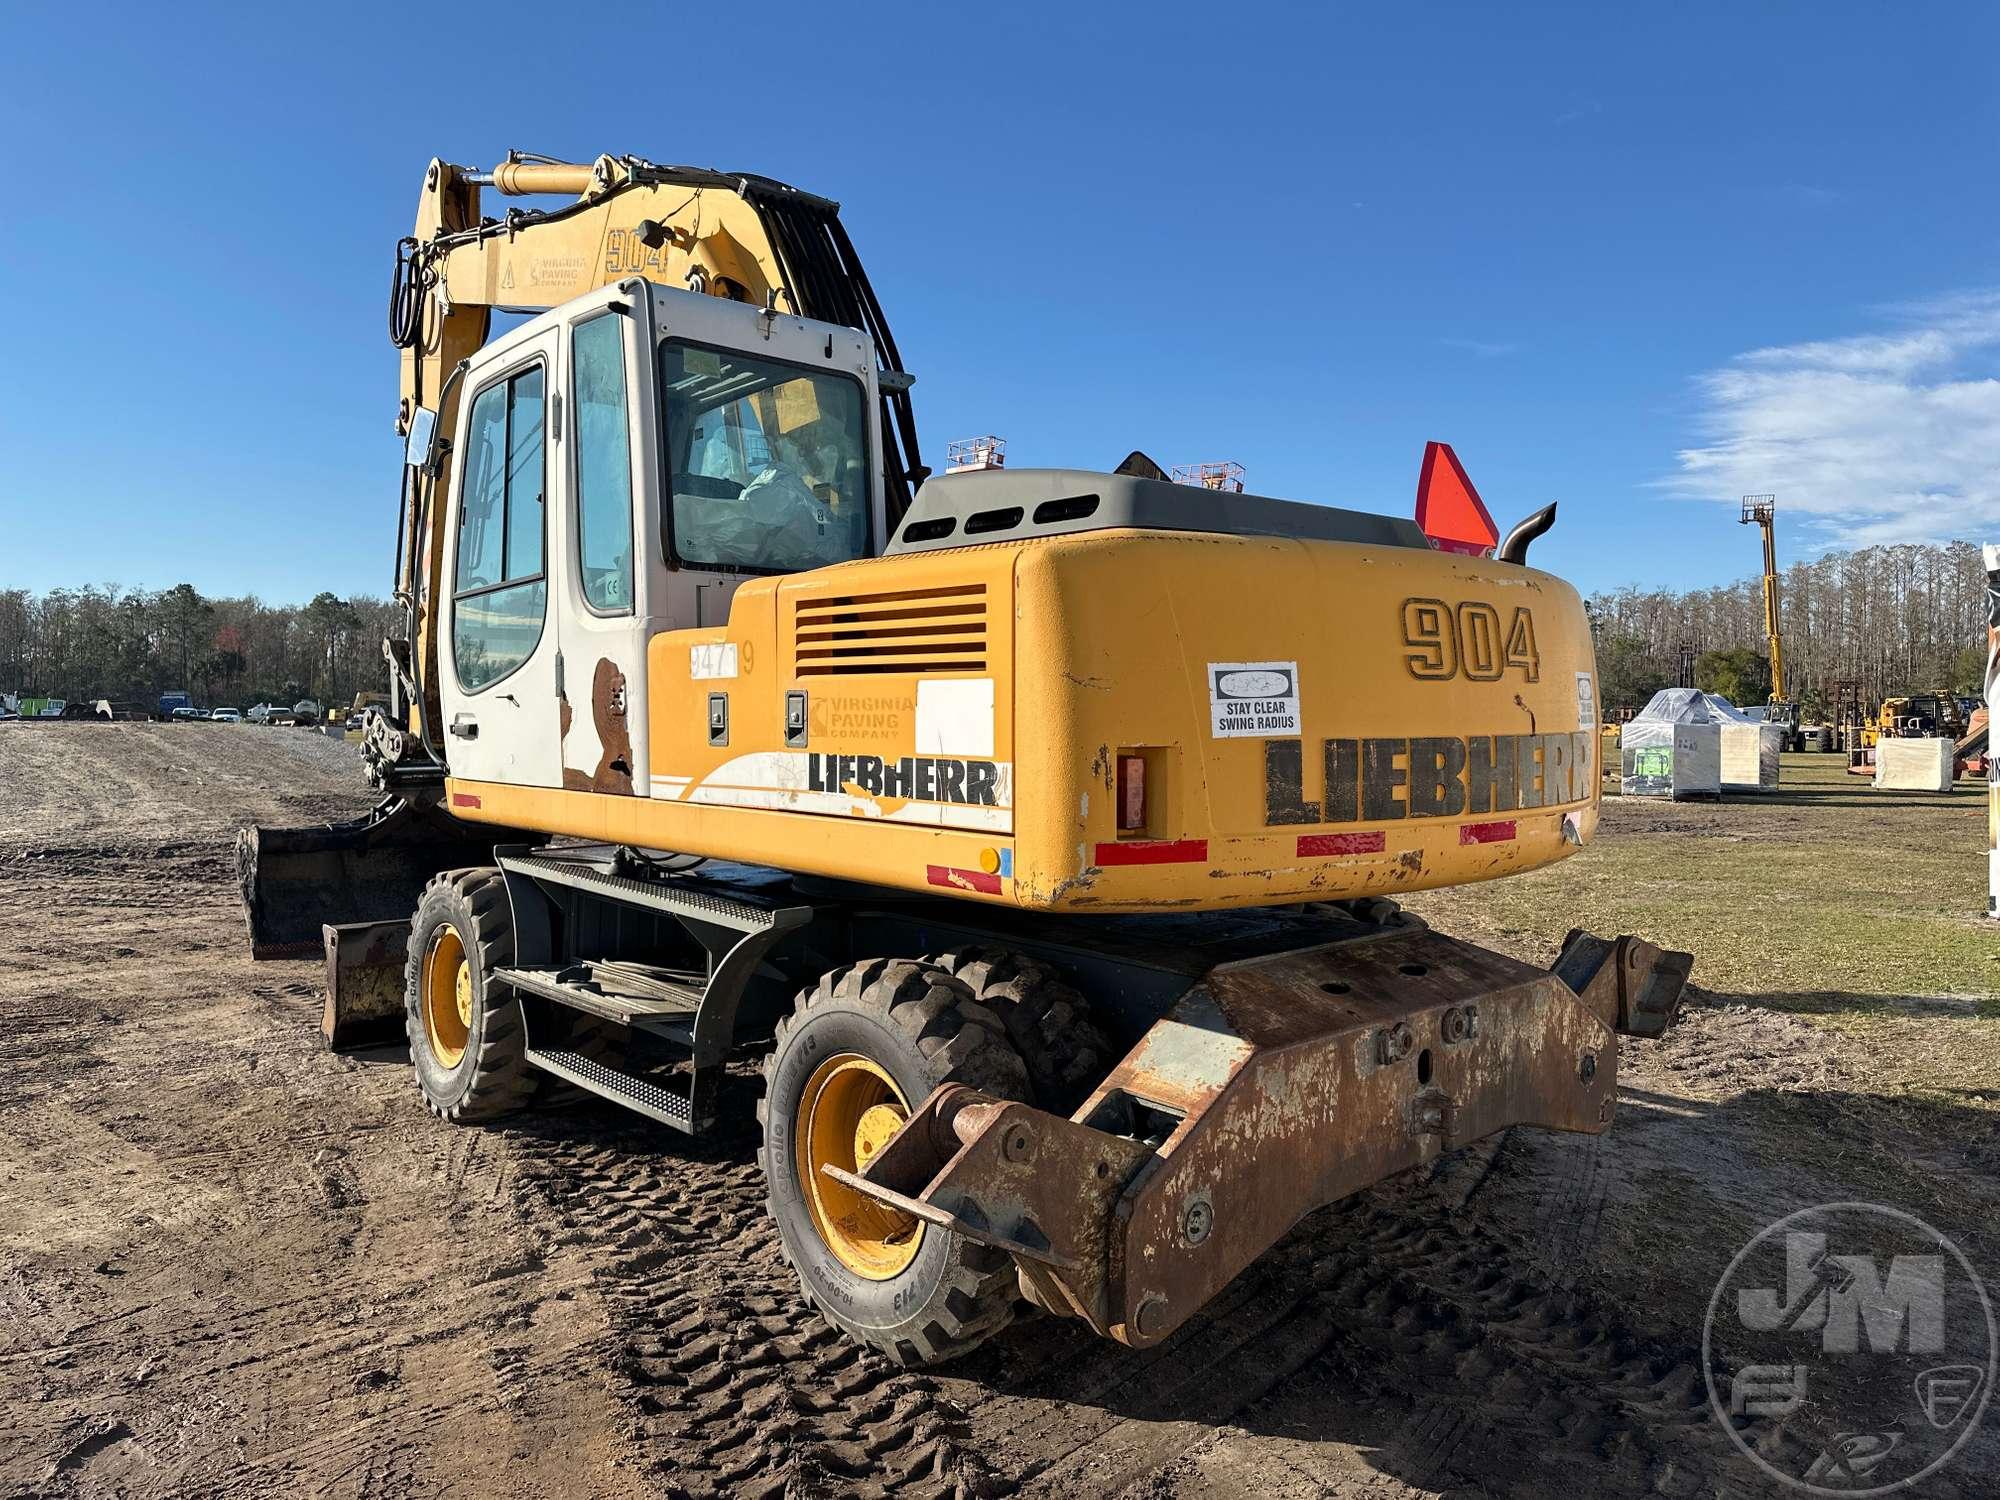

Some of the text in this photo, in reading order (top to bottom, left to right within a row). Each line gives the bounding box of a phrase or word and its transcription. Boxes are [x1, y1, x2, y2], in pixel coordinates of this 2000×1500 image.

[606, 229, 669, 274] 904
[542, 269, 578, 279] PAVING
[1402, 597, 1540, 683] 904
[830, 697, 915, 712] VIRGINIA
[1227, 701, 1286, 715] STAY CLEAR
[831, 714, 899, 729] PAVING
[1219, 716, 1294, 731] SWING RADIUS
[830, 730, 899, 739] COMPANY
[808, 753, 999, 807] LIEBHERR
[1264, 731, 1591, 827] LIEBHERR
